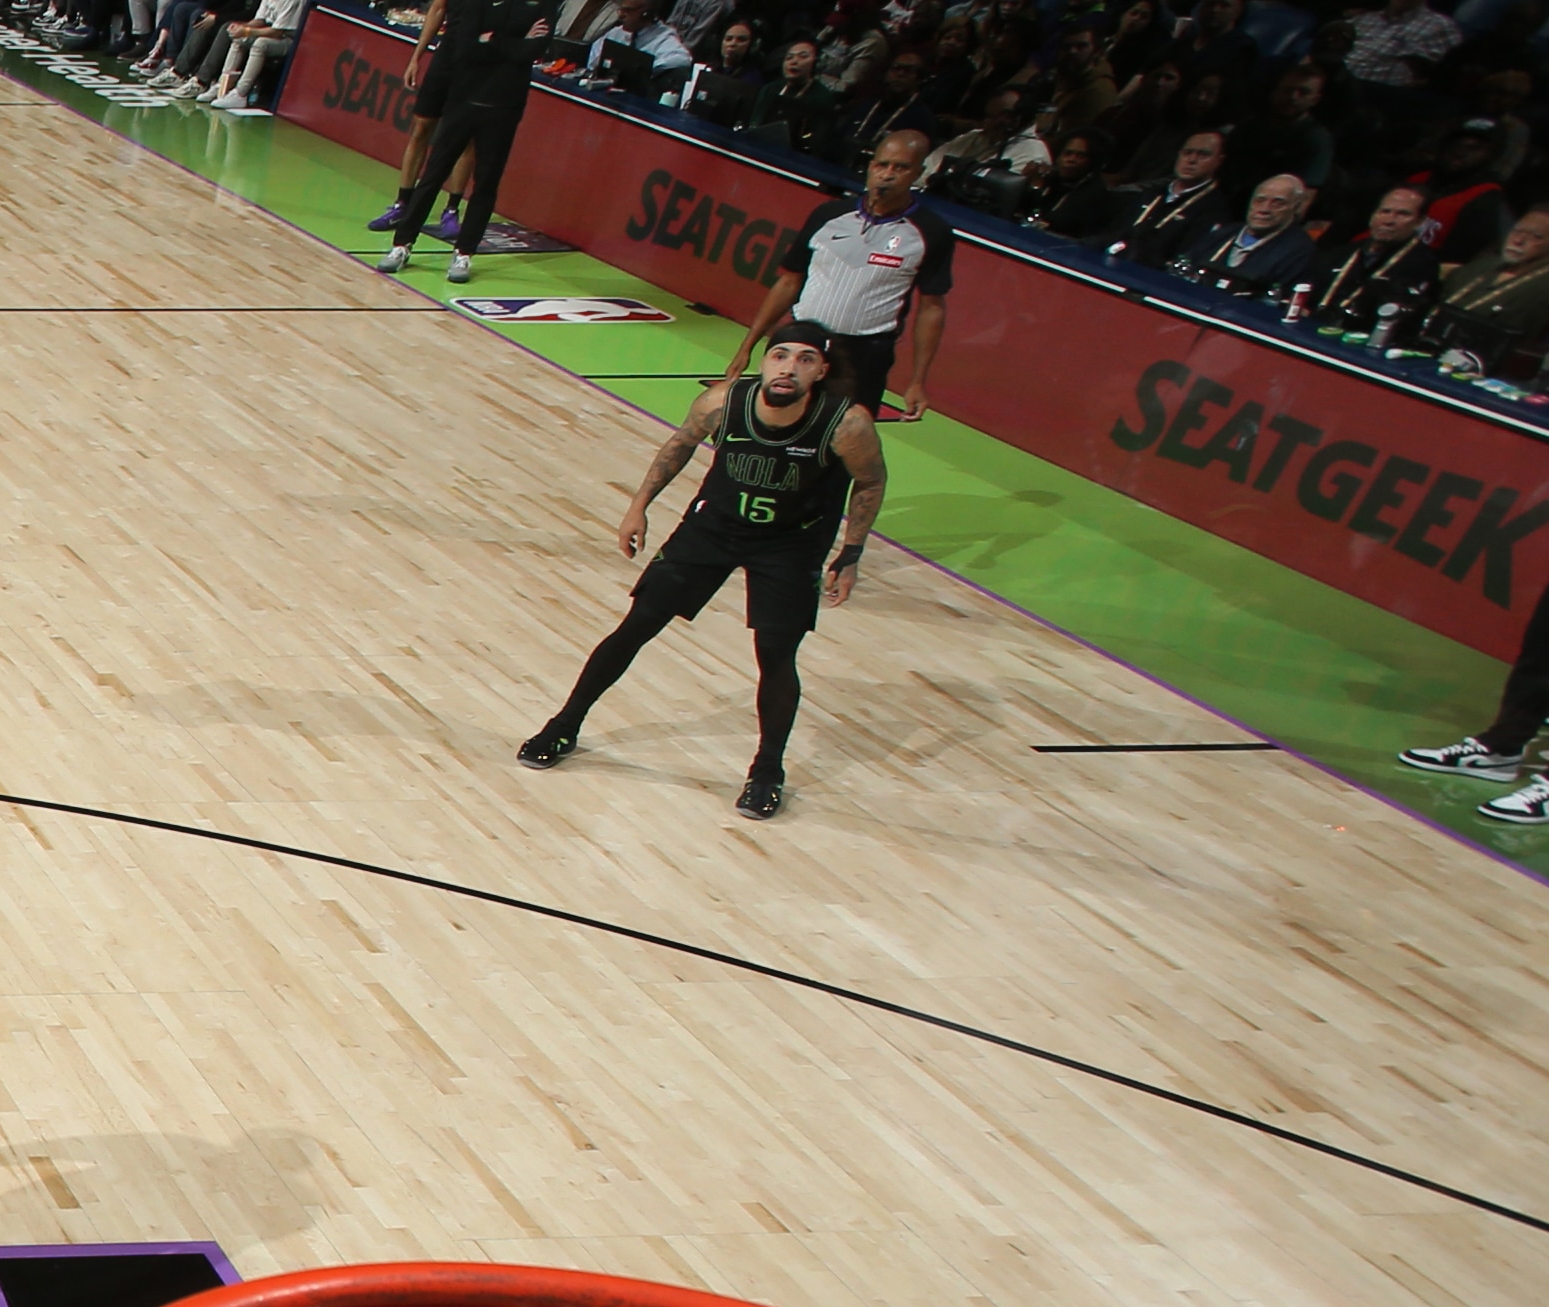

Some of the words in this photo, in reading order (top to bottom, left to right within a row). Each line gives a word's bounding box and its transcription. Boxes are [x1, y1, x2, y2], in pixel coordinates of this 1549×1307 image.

[20, 53, 177, 108] Health
[323, 49, 418, 133] SEATG
[626, 169, 796, 289] SEATGE
[727, 452, 800, 491] NOLA
[1109, 359, 1549, 610] SEATGEEK
[739, 492, 776, 524] 15
